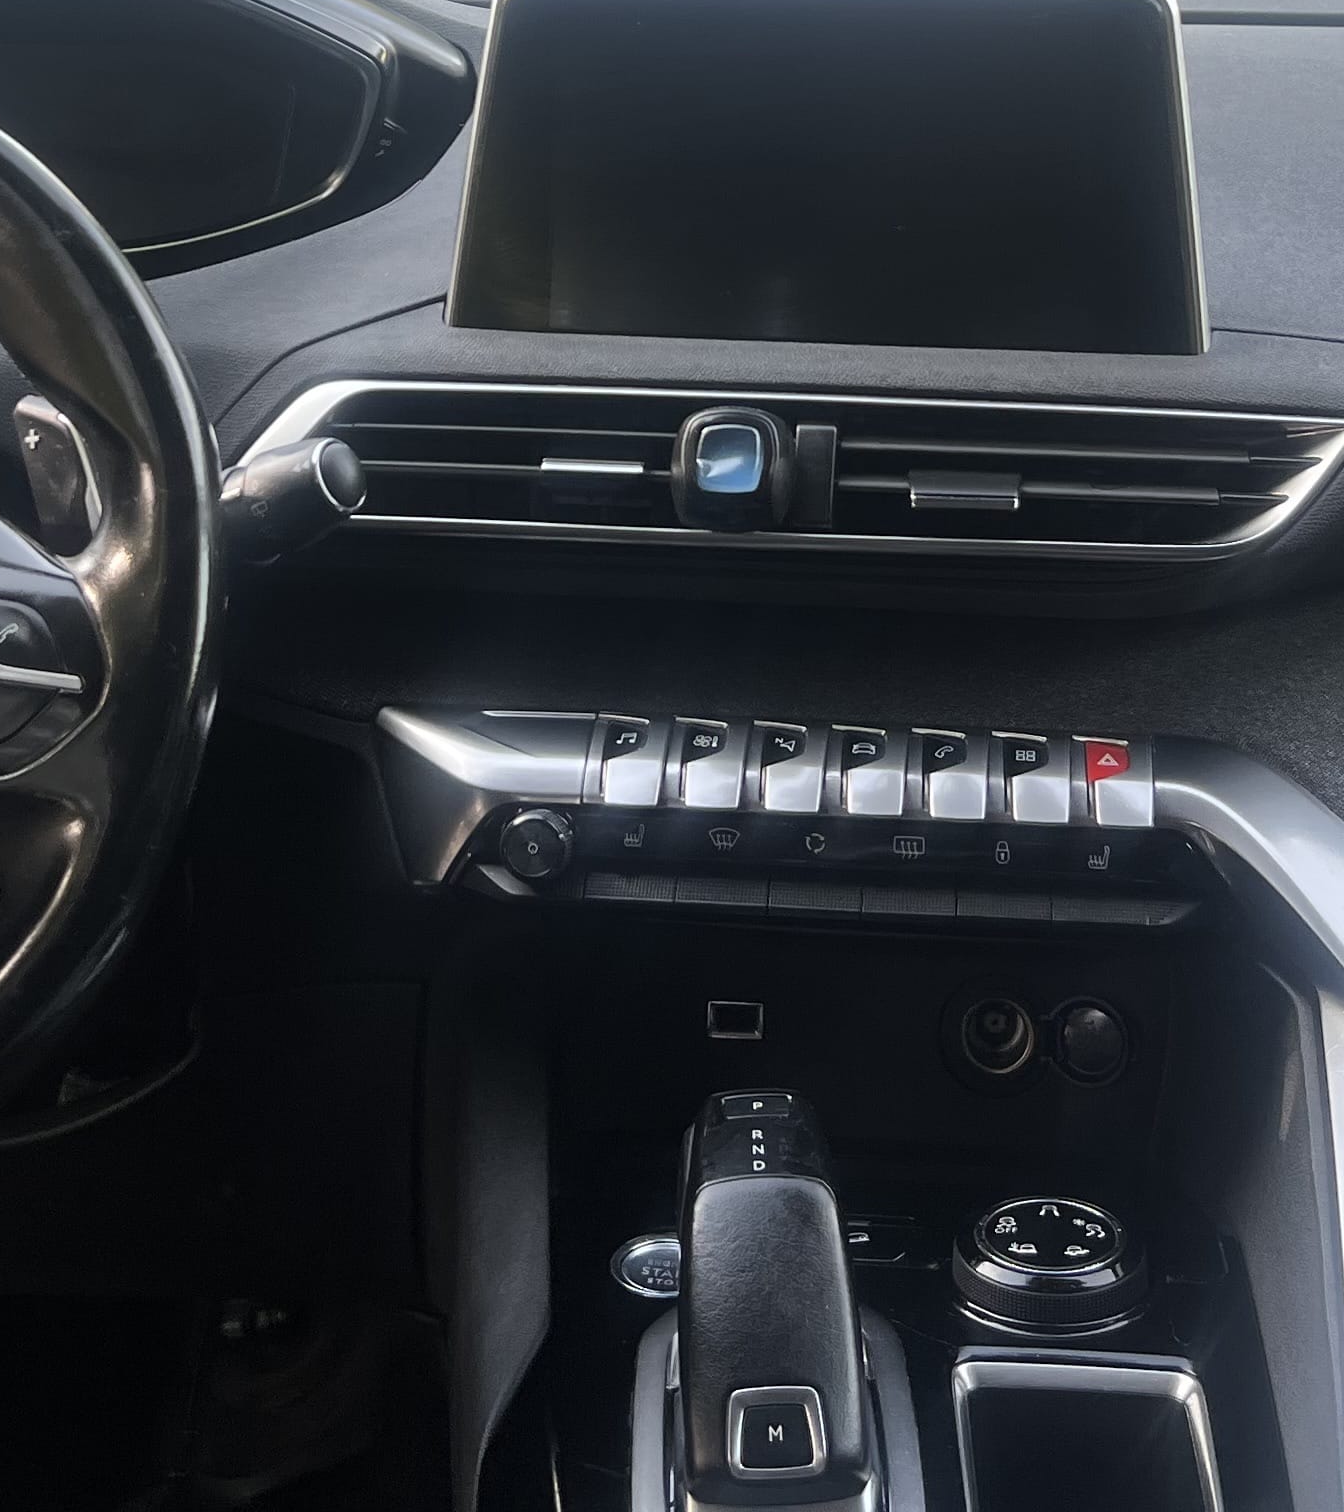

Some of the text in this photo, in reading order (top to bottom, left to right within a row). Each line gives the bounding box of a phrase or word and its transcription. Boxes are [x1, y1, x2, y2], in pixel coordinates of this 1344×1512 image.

[752, 1101, 763, 1110] P
[751, 1129, 764, 1140] R
[752, 1143, 765, 1155] N
[753, 1160, 766, 1171] D
[994, 1226, 1018, 1234] OFF
[647, 1277, 675, 1285] STO
[768, 1424, 783, 1442] M
